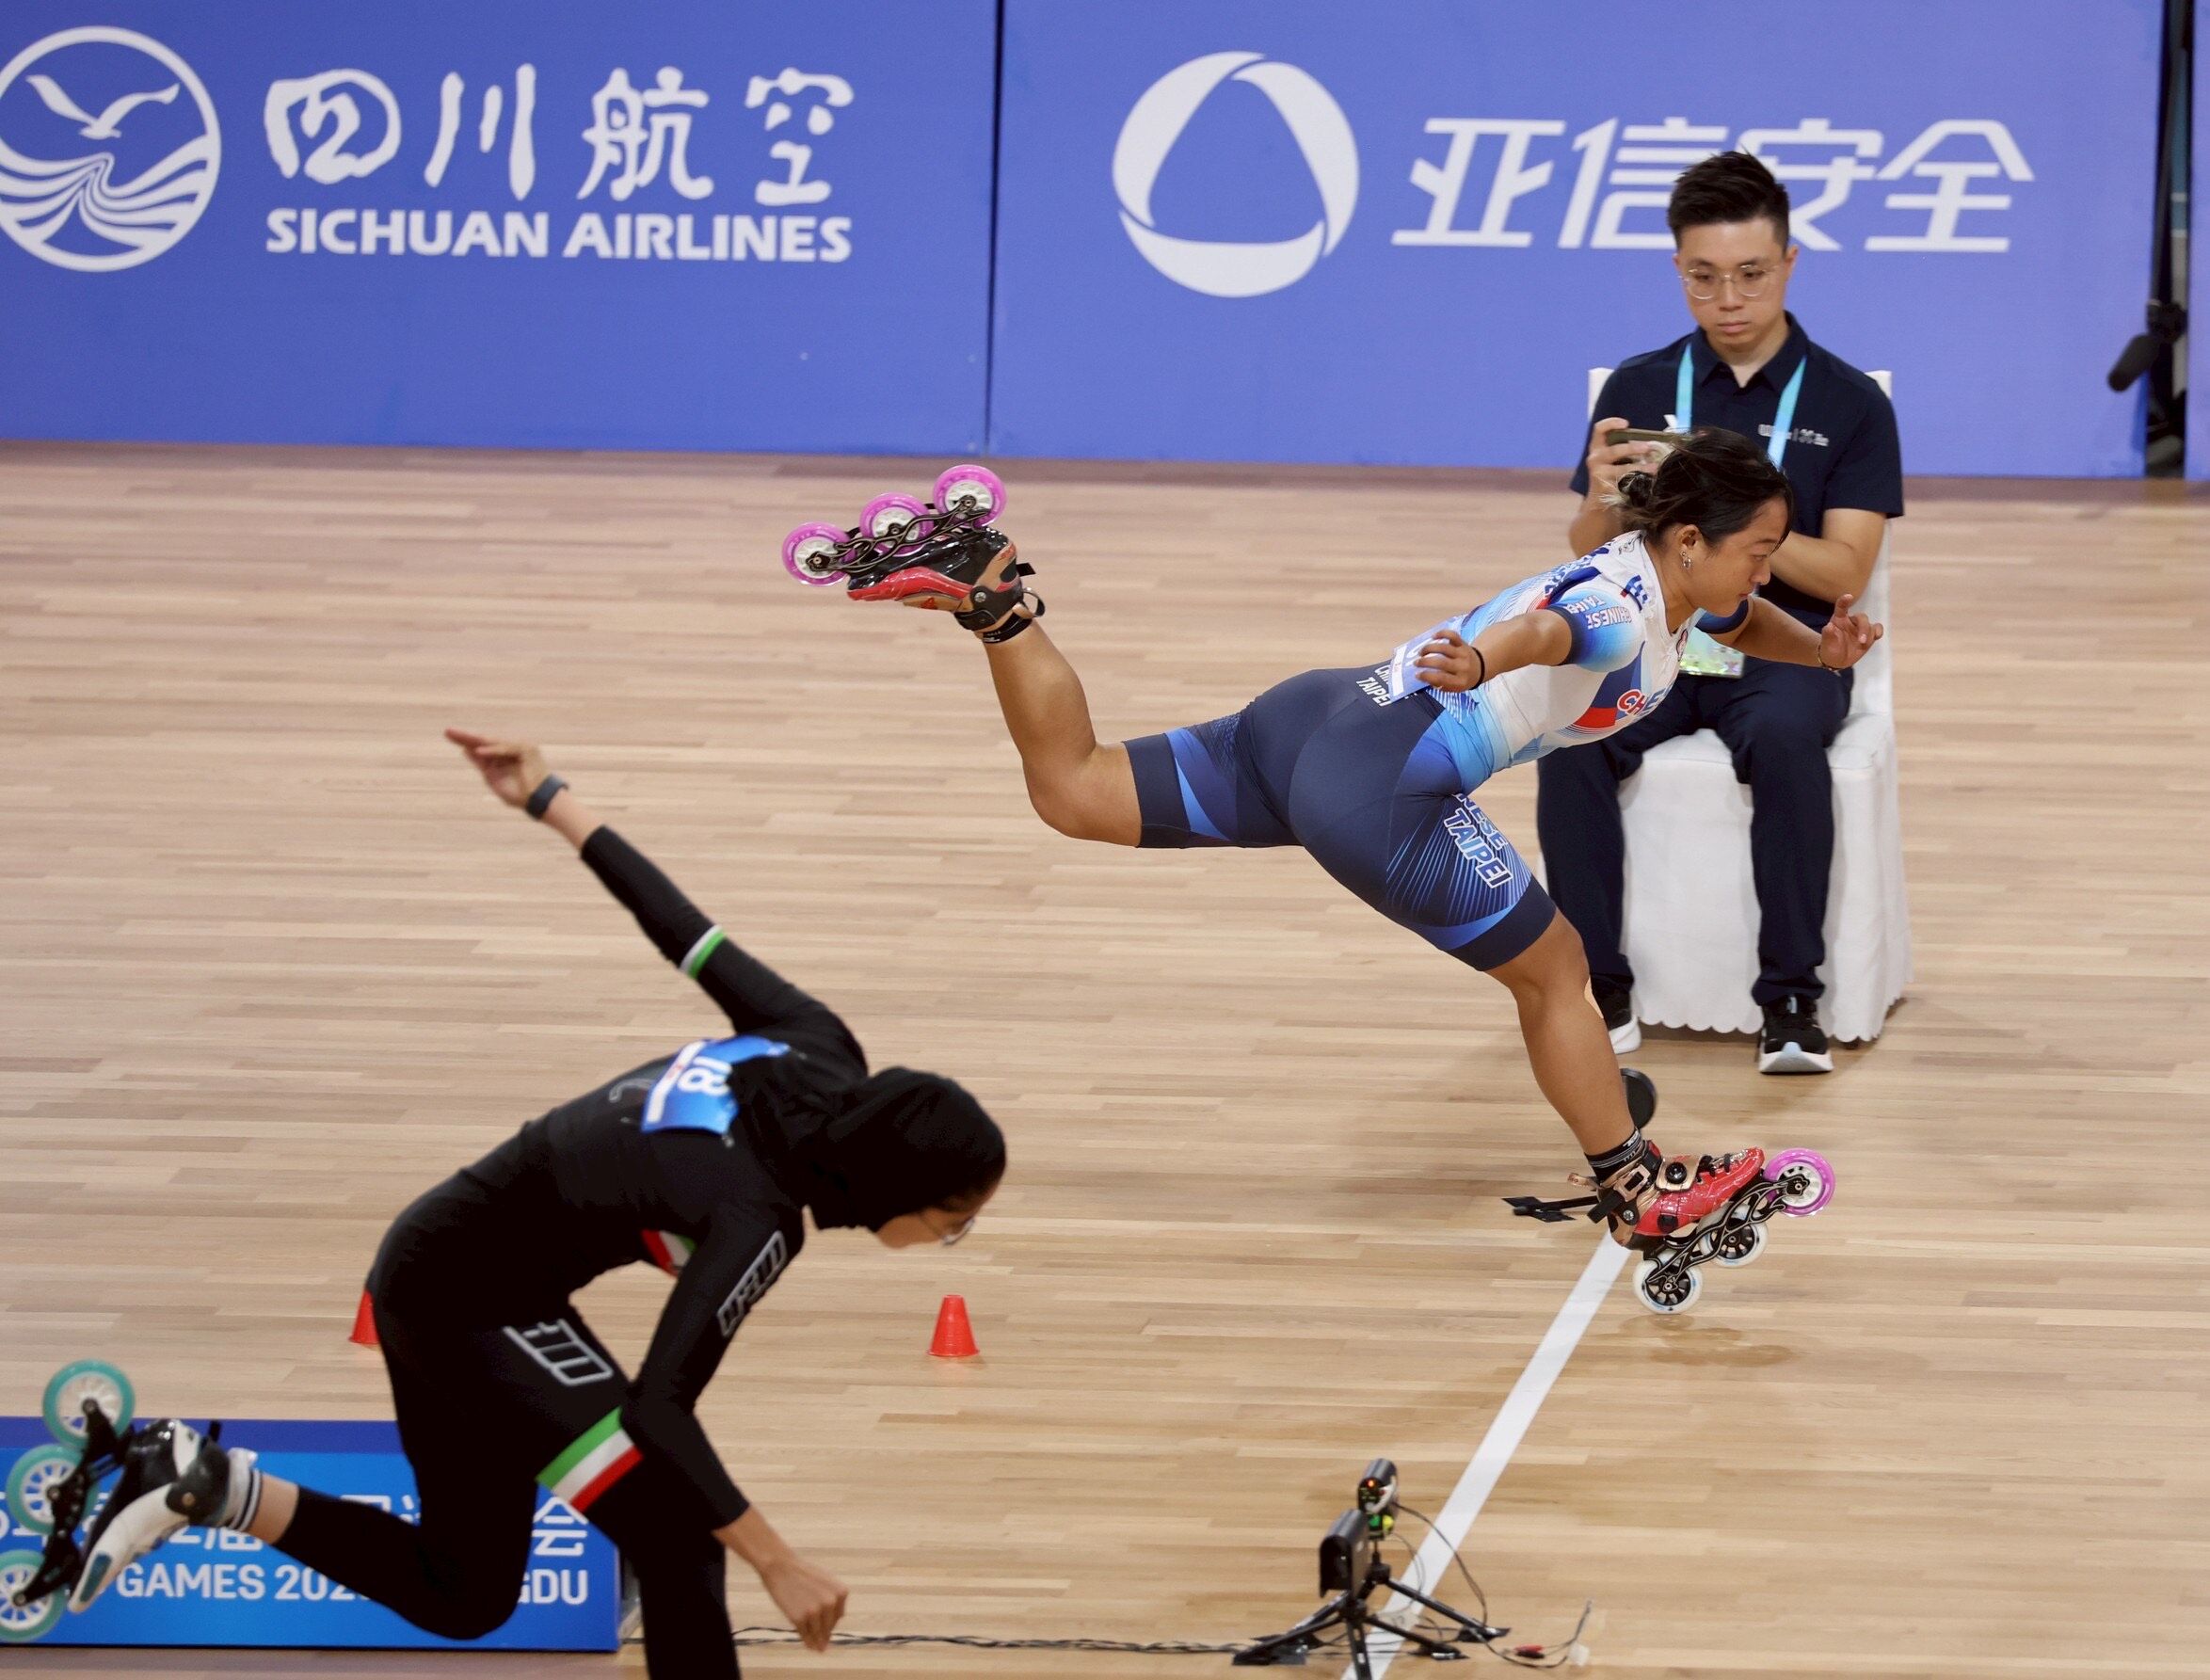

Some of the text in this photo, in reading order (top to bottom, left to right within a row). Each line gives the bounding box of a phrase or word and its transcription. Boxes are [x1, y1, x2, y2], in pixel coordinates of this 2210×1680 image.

[264, 63, 855, 206] 四川航空
[1391, 116, 2035, 252] 亚信安全
[265, 207, 853, 264] SICHUAN AIRLINES
[1355, 676, 1392, 707] TAIPEI
[1443, 807, 1513, 888] TAIPEI
[116, 1561, 266, 1600] GAMES
[274, 1564, 374, 1601] 20
